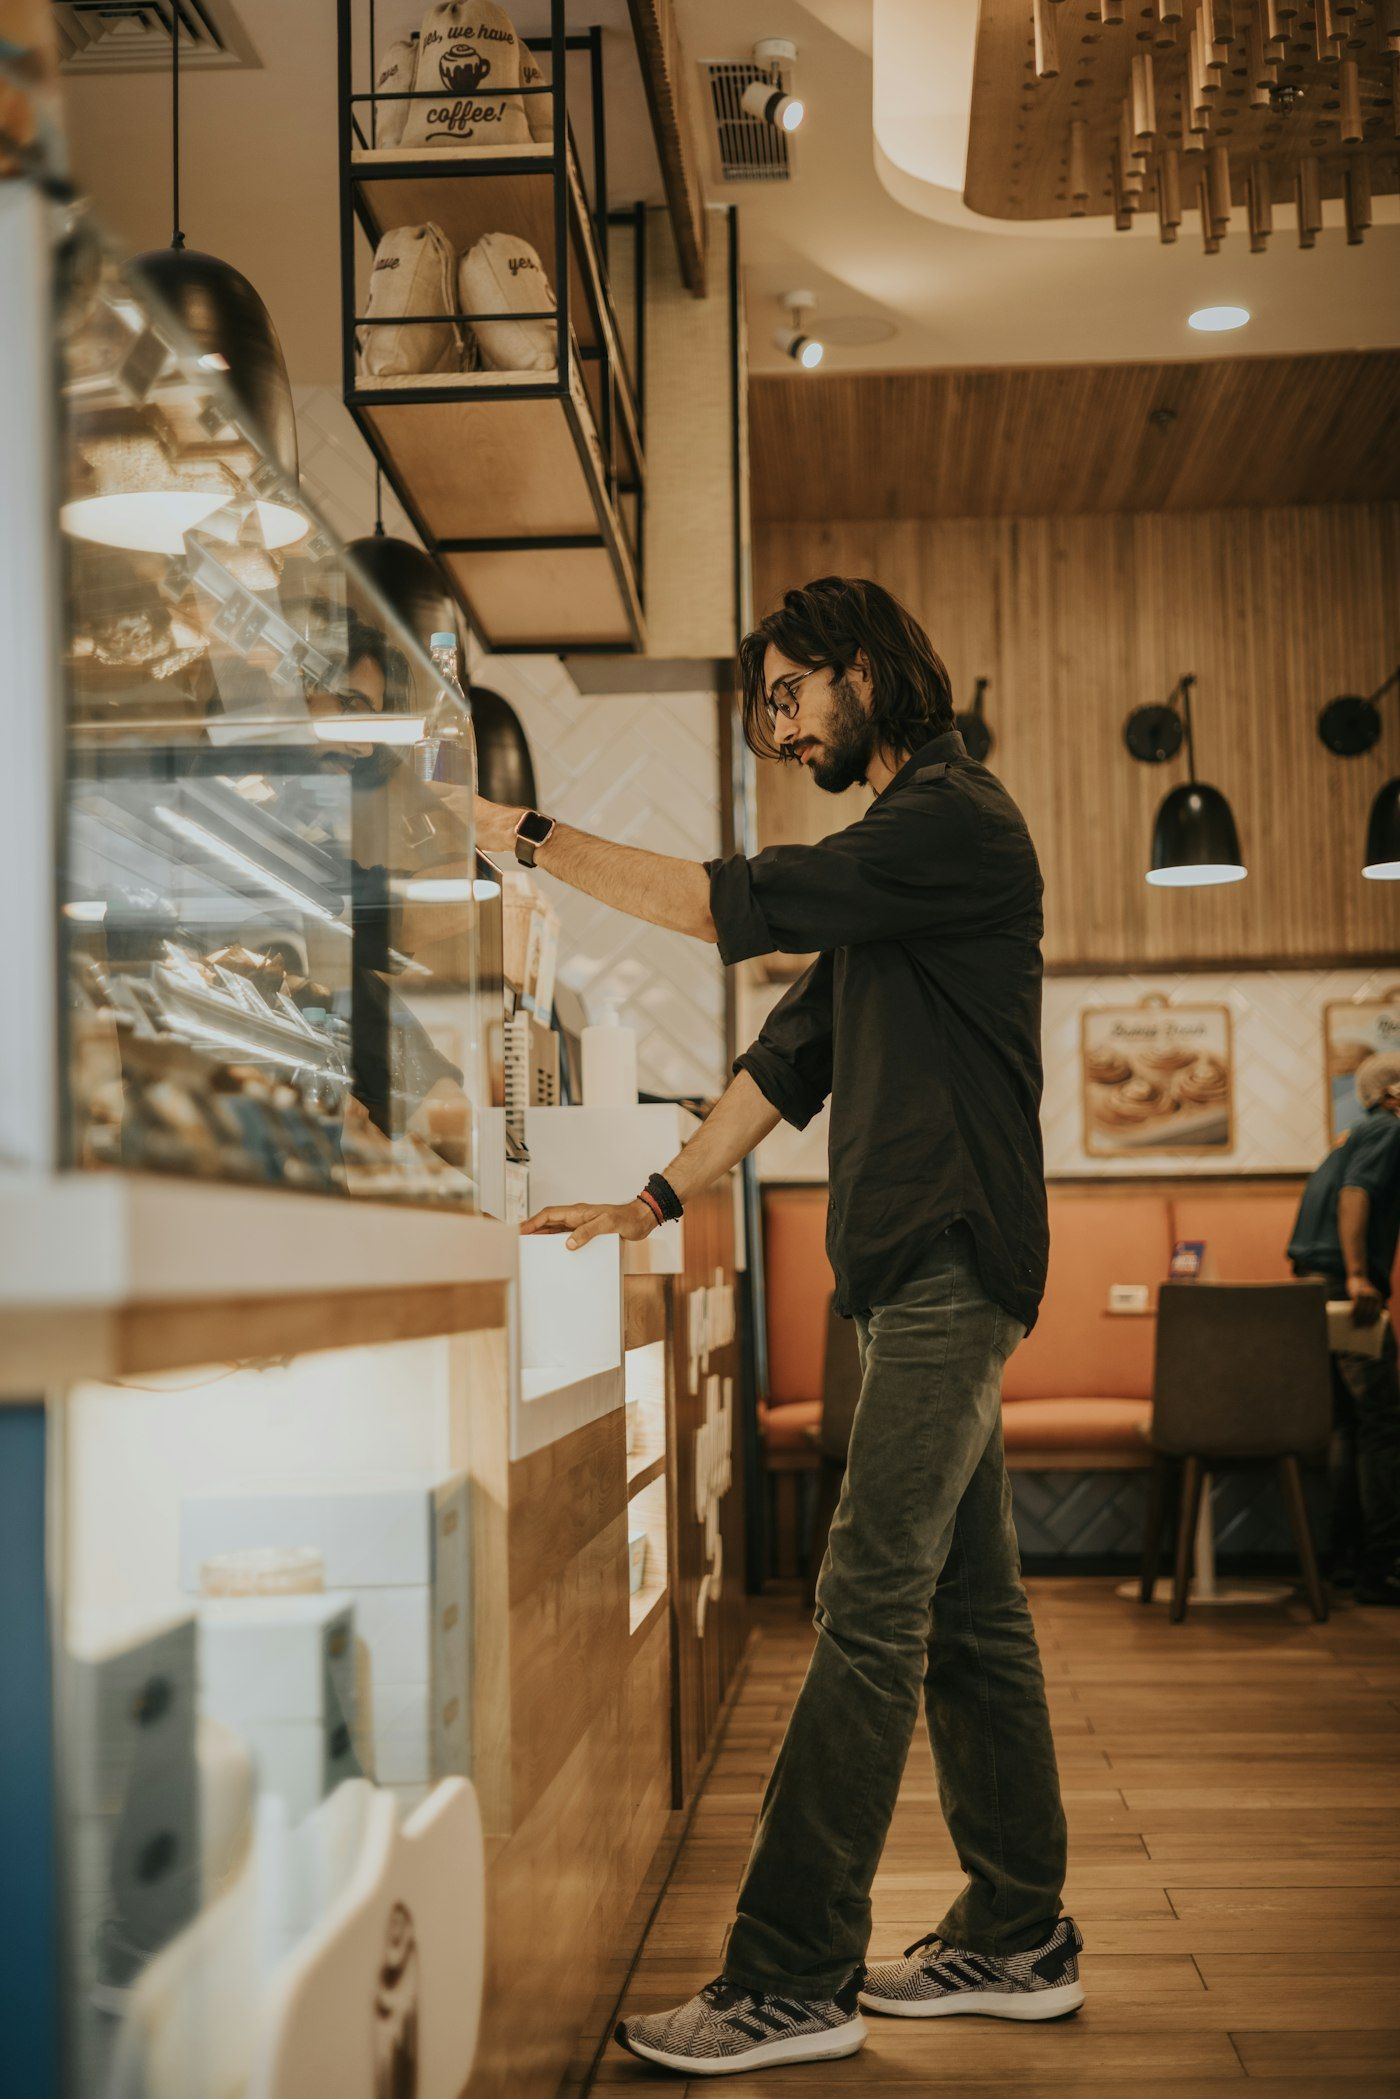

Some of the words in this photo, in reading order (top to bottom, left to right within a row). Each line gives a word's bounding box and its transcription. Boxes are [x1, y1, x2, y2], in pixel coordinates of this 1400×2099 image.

[447, 26, 475, 39] we
[477, 23, 514, 45] have
[426, 100, 507, 131] coffee!
